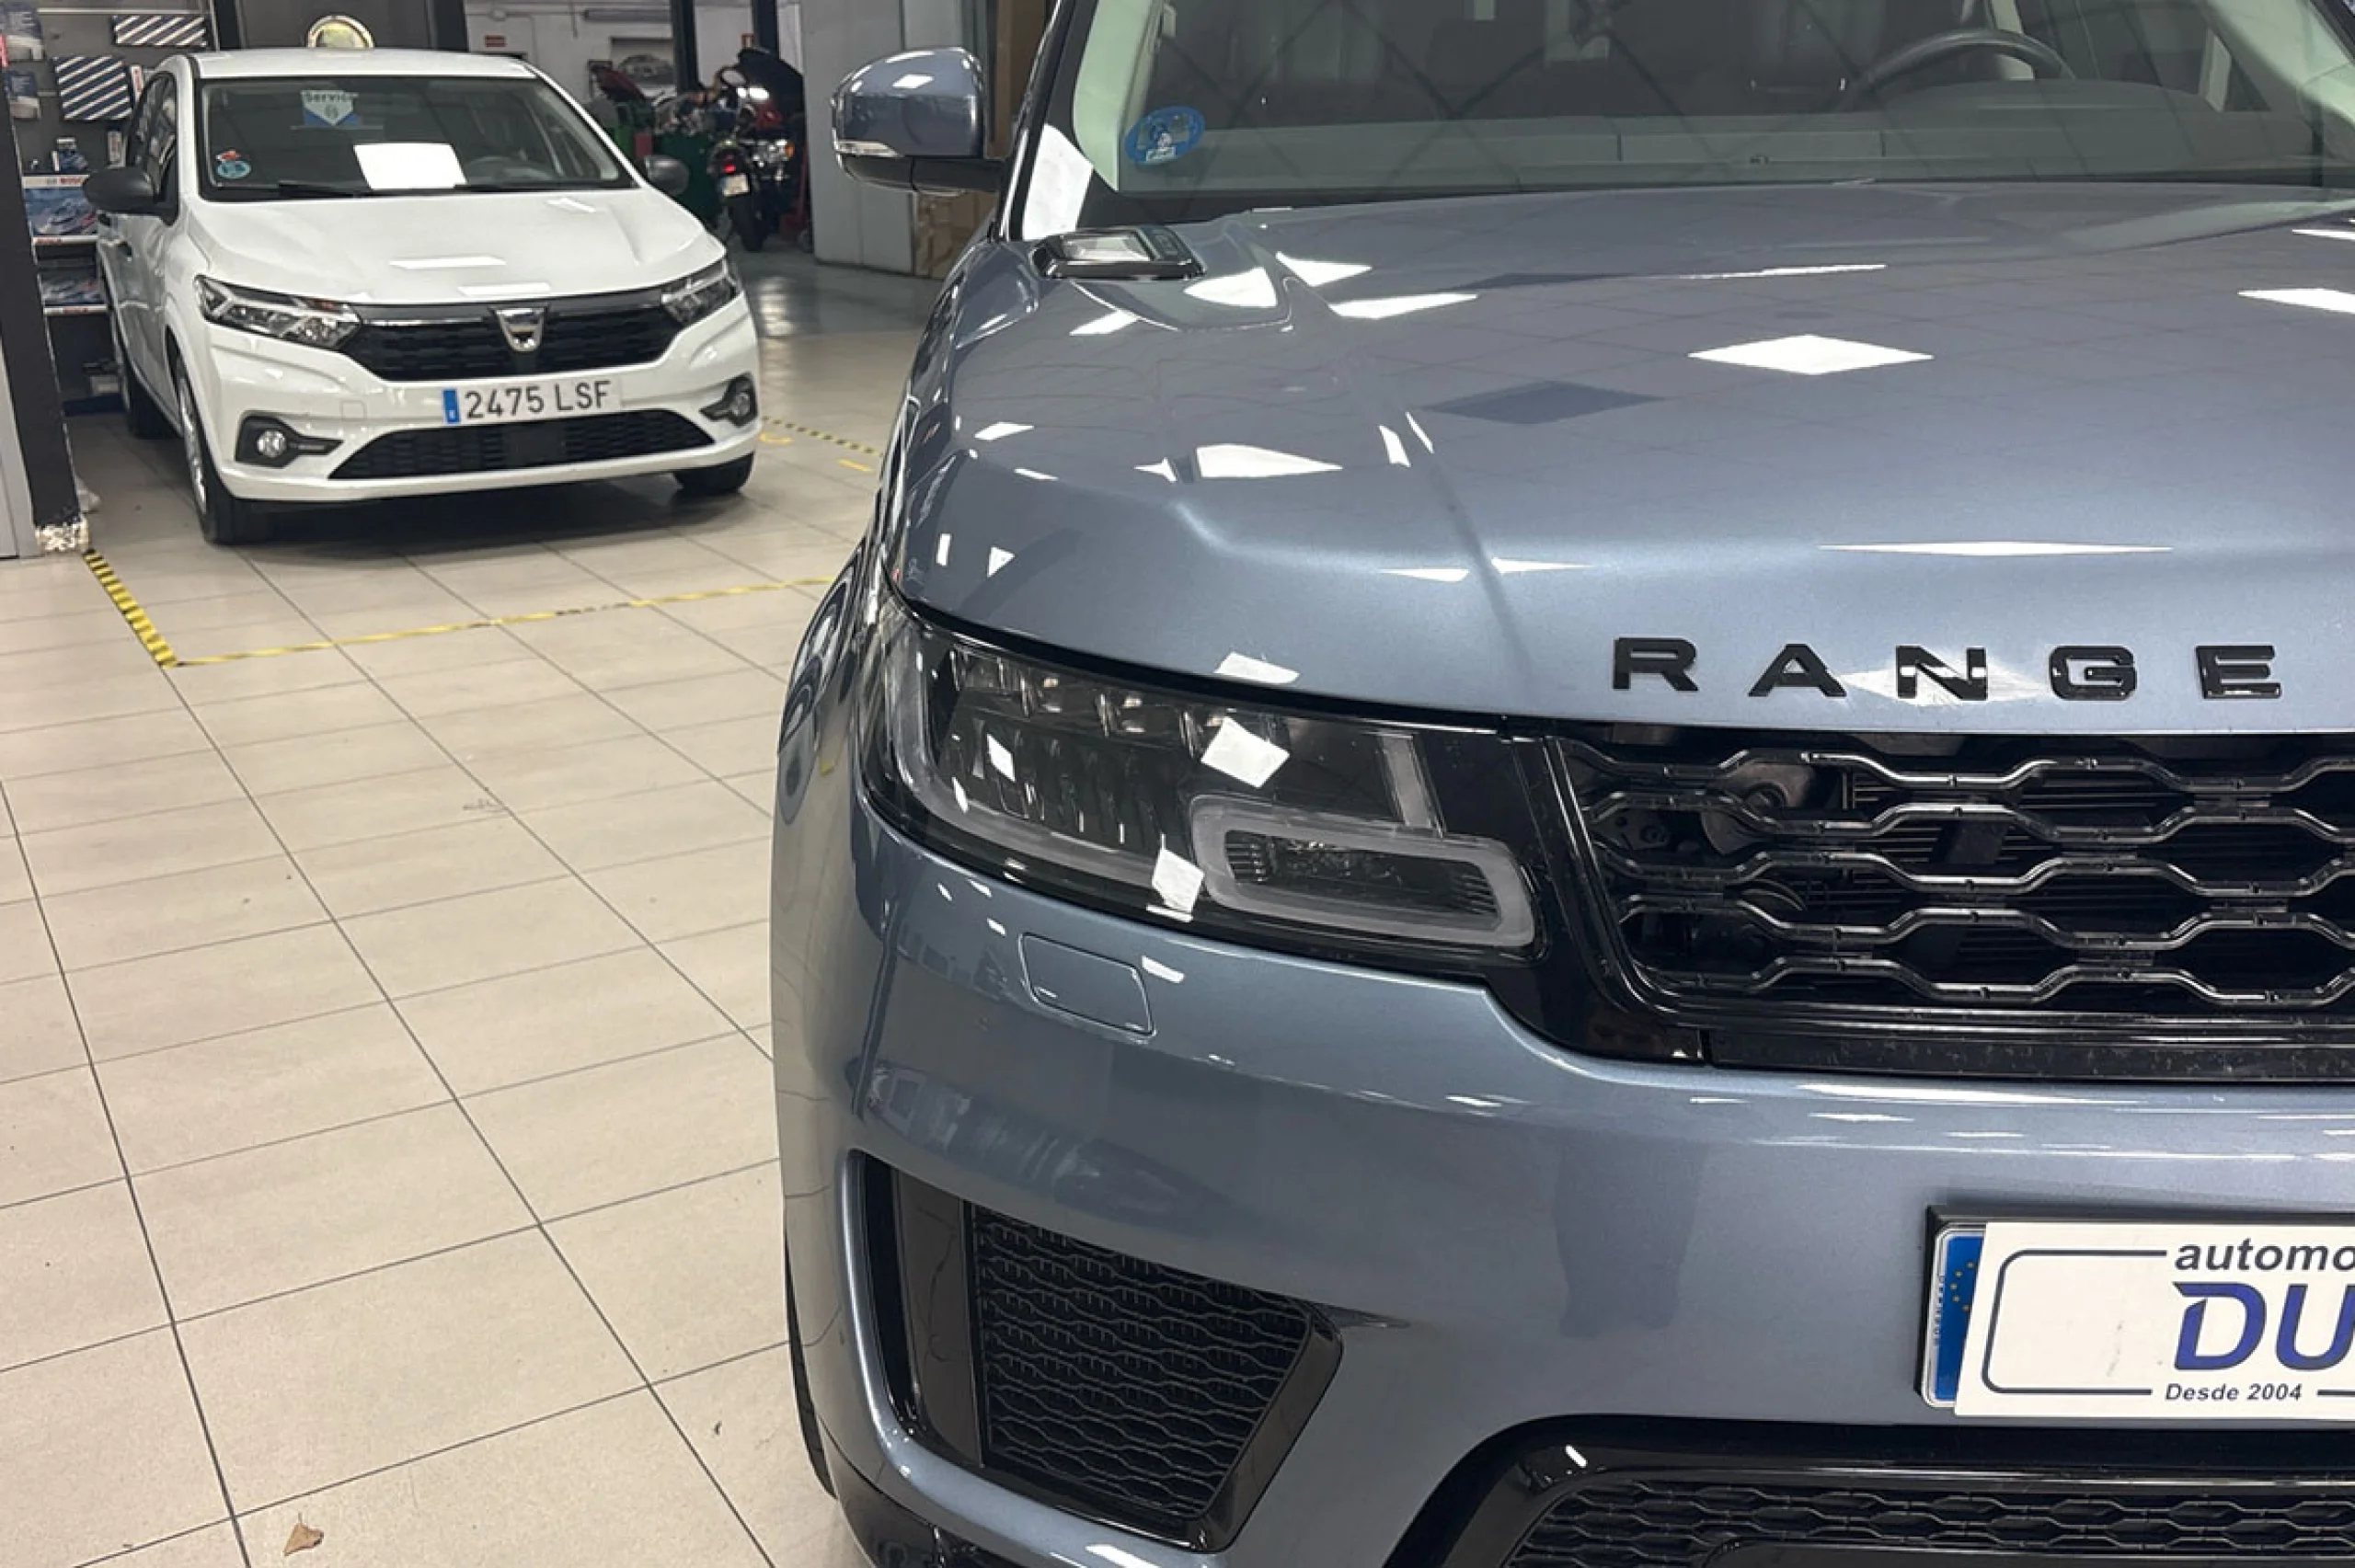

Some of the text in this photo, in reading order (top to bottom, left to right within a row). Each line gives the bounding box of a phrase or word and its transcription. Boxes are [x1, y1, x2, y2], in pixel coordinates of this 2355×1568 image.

[465, 380, 611, 419] 2475 LSF
[1613, 636, 2281, 701] RANGE
[2175, 1238, 2355, 1271] automo
[2172, 1281, 2355, 1371] DU
[2165, 1383, 2302, 1401] Desde 2004
